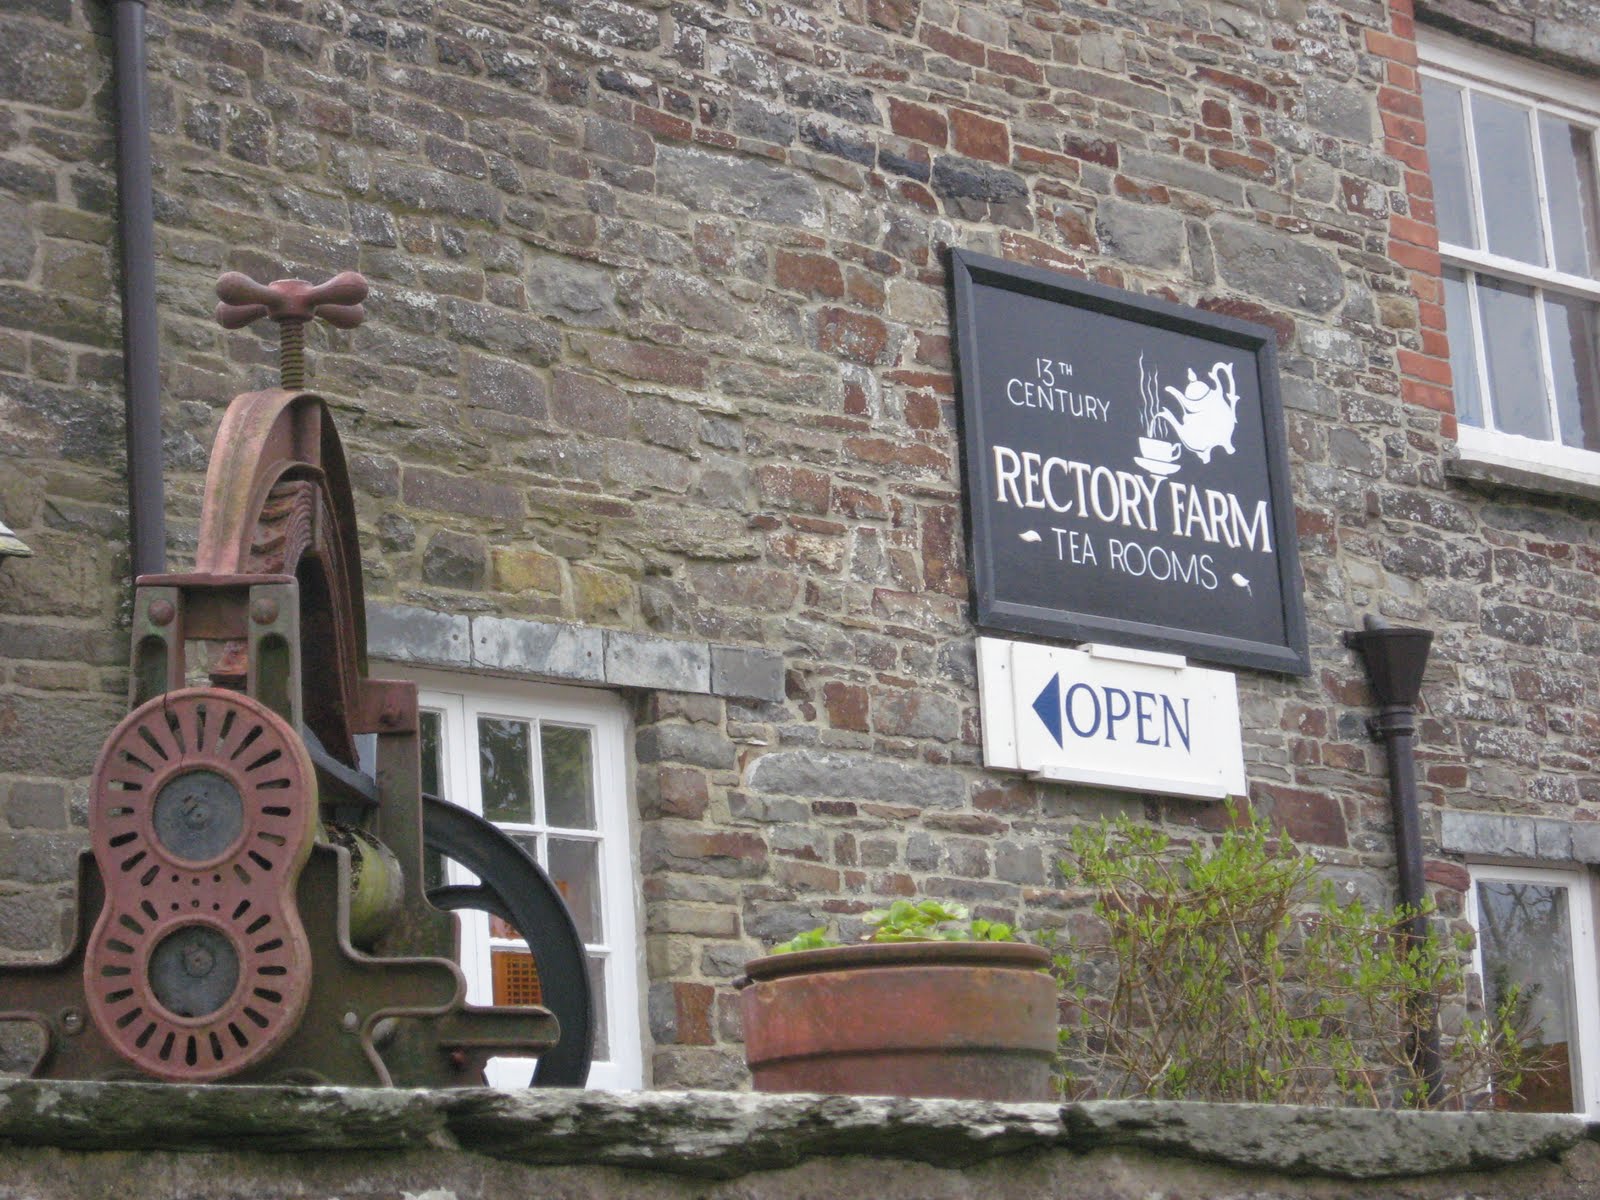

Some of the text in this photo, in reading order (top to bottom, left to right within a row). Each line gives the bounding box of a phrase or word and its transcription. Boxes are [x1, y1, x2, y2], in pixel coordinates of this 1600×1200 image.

[1007, 378, 1110, 422] CENTURY
[993, 445, 1273, 552] RECTORY FARM
[1051, 527, 1218, 590] TEA ROOMS
[1065, 682, 1190, 754] OPEN
